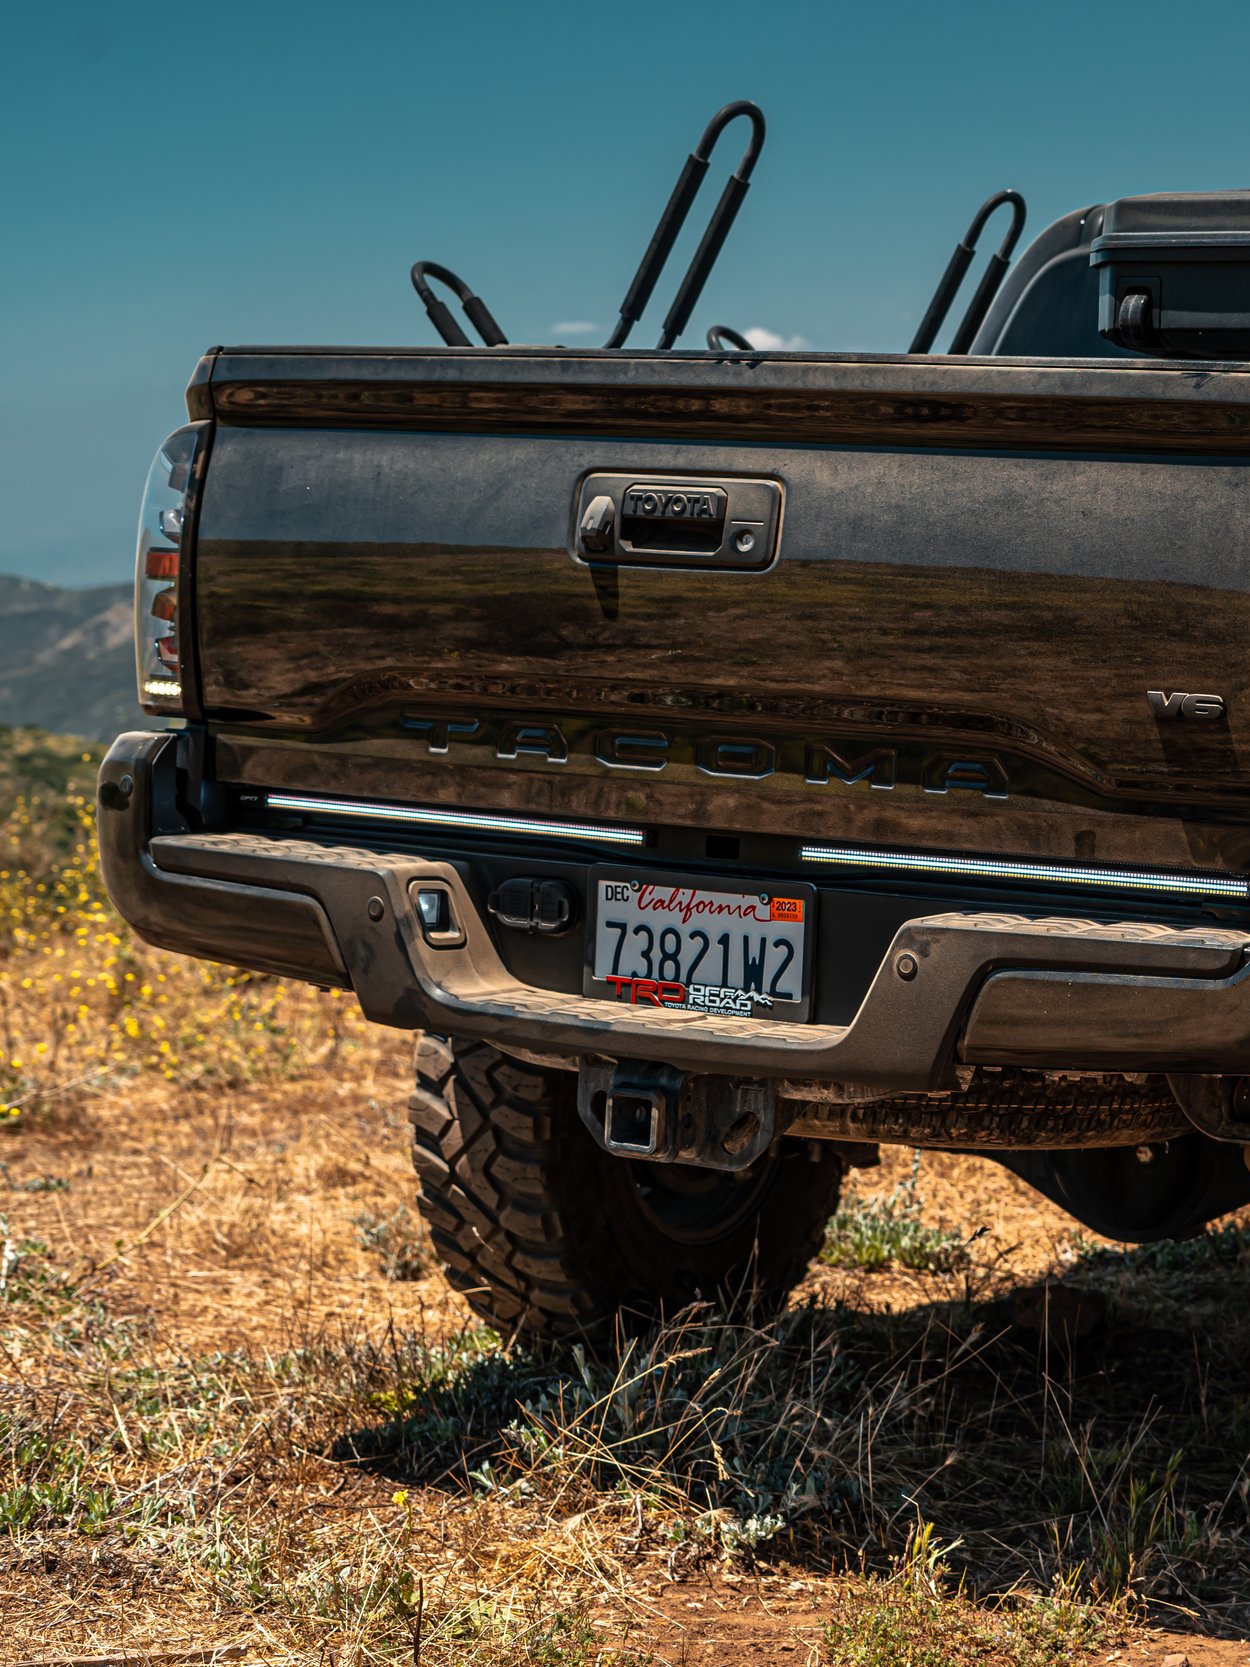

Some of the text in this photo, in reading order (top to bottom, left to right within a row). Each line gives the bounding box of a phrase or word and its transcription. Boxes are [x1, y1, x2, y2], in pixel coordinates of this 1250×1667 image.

[629, 492, 714, 517] TOYOTA
[1146, 690, 1223, 719] V6
[403, 713, 1009, 799] TACOMA
[605, 884, 630, 902] DEC
[636, 884, 771, 924] California
[776, 901, 797, 912] 2023
[605, 920, 795, 1000] 73821W2
[606, 975, 686, 1008] TRD
[689, 984, 737, 999] OFF
[689, 995, 752, 1011] ROAD
[664, 1002, 686, 1010] TOYOTA
[710, 1007, 752, 1017] DEVELOPMENT
